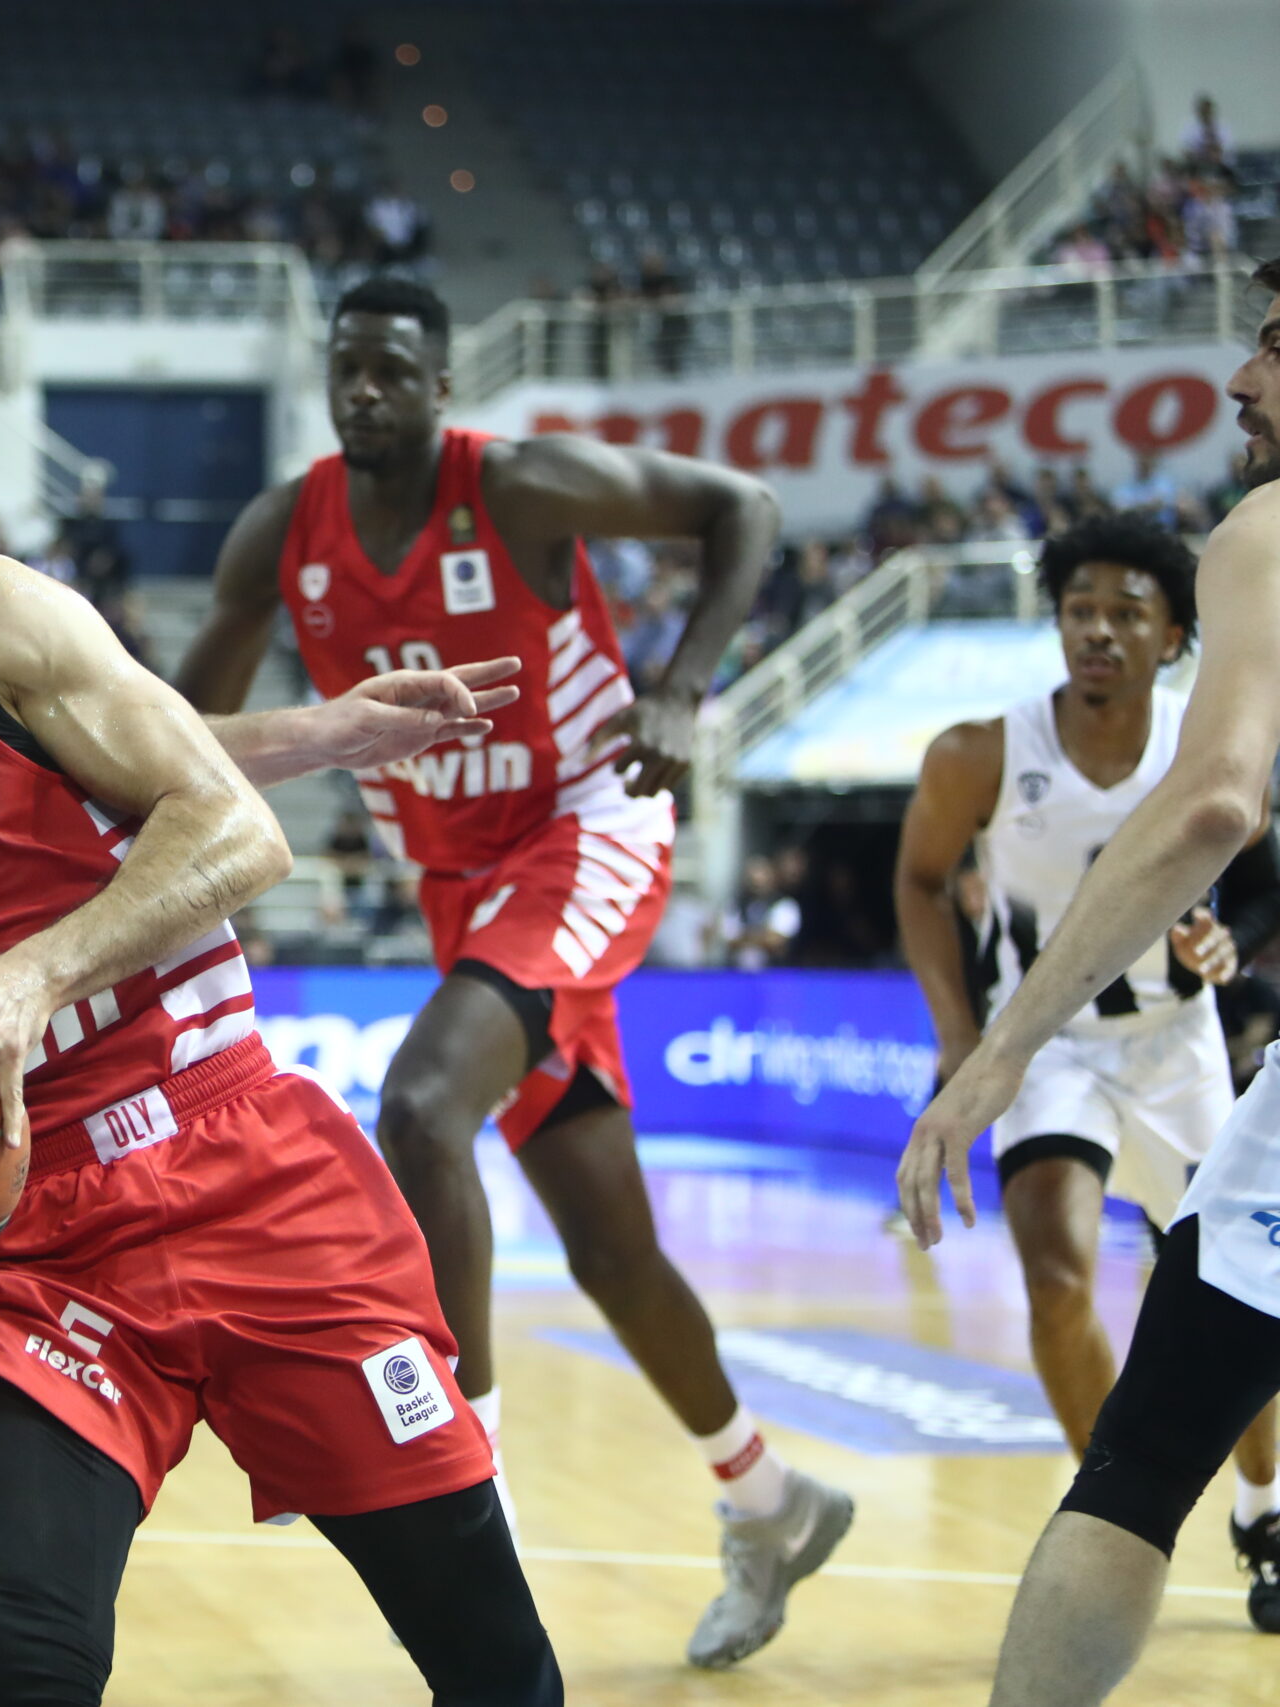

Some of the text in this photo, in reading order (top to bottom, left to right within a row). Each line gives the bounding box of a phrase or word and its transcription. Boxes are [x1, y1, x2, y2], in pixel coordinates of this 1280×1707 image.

[386, 735, 532, 799] win
[104, 1097, 155, 1148] OLY
[25, 1333, 122, 1405] FlexCar
[396, 1391, 435, 1416] Basket
[401, 1403, 439, 1427] League
